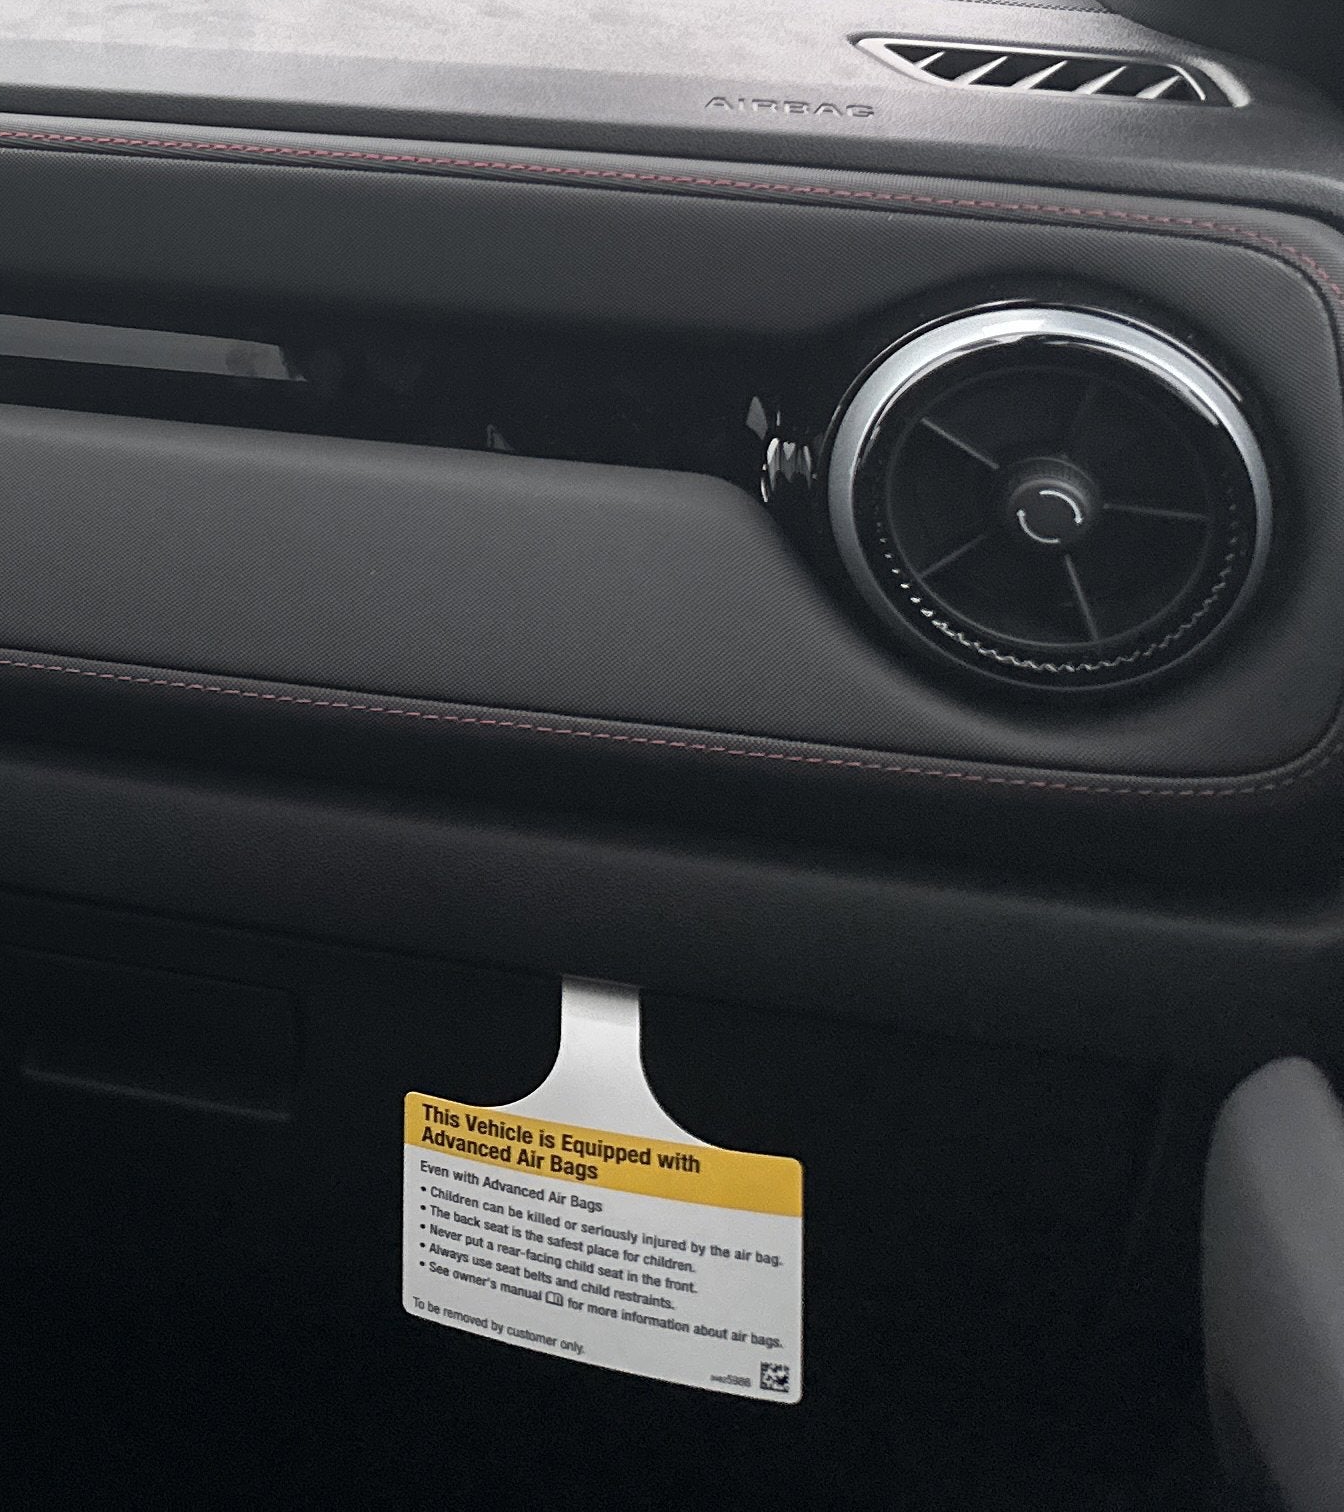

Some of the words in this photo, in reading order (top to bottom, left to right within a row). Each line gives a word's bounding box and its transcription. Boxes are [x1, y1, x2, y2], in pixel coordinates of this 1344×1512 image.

[705, 96, 875, 118] AIRBAG
[421, 1126, 512, 1163] Advanced
[516, 1148, 545, 1169] Air
[549, 1155, 599, 1181] Bags
[422, 1103, 460, 1128] This
[465, 1113, 534, 1145] Vehicle
[539, 1129, 555, 1149] is
[562, 1134, 652, 1166] Equipped
[657, 1152, 701, 1174] with
[420, 1159, 449, 1178] Even
[453, 1170, 480, 1186] with
[482, 1176, 545, 1201] Advanced
[548, 1191, 567, 1205] Air
[570, 1194, 603, 1214] Bags
[429, 1204, 451, 1220] The
[453, 1210, 481, 1228] back
[484, 1220, 510, 1236] seat
[511, 1225, 522, 1238] is
[525, 1228, 544, 1243] the
[547, 1234, 583, 1252] safest
[586, 1243, 619, 1260] place
[623, 1250, 640, 1263] for
[643, 1255, 697, 1274] children.
[429, 1223, 463, 1242] Never
[465, 1235, 484, 1251] put
[487, 1241, 495, 1251] a
[497, 1243, 562, 1269] rear-facing
[565, 1258, 594, 1275] child
[597, 1264, 624, 1281] seat
[627, 1270, 639, 1283] in
[642, 1273, 661, 1287] the
[665, 1277, 698, 1294] front.
[430, 1185, 479, 1209] Children
[482, 1201, 505, 1215] can
[508, 1205, 524, 1219] be
[527, 1210, 561, 1228] killed
[564, 1219, 578, 1231] or
[581, 1223, 638, 1245] seriously
[642, 1232, 687, 1252] injured
[690, 1241, 706, 1257] by
[710, 1244, 730, 1258] the
[734, 1249, 753, 1262] air
[755, 1250, 784, 1267] bag.
[429, 1242, 470, 1264] Always
[472, 1256, 493, 1270] use
[495, 1261, 521, 1277] seat
[524, 1267, 553, 1284] belts
[555, 1274, 578, 1290] and
[581, 1281, 611, 1298] child
[613, 1289, 676, 1310] restraints.
[429, 1261, 450, 1278] See
[452, 1268, 497, 1290] owner's
[500, 1282, 543, 1301] manual
[567, 1298, 584, 1312] for
[587, 1305, 618, 1319] more
[621, 1309, 690, 1333] information
[693, 1324, 729, 1340] about
[731, 1331, 748, 1343] air
[750, 1332, 784, 1349] bags.
[412, 1296, 425, 1310] To
[427, 1301, 441, 1315] be
[443, 1307, 489, 1329] removed
[491, 1320, 504, 1335] by
[506, 1326, 558, 1347] customer
[559, 1339, 585, 1356] only.
